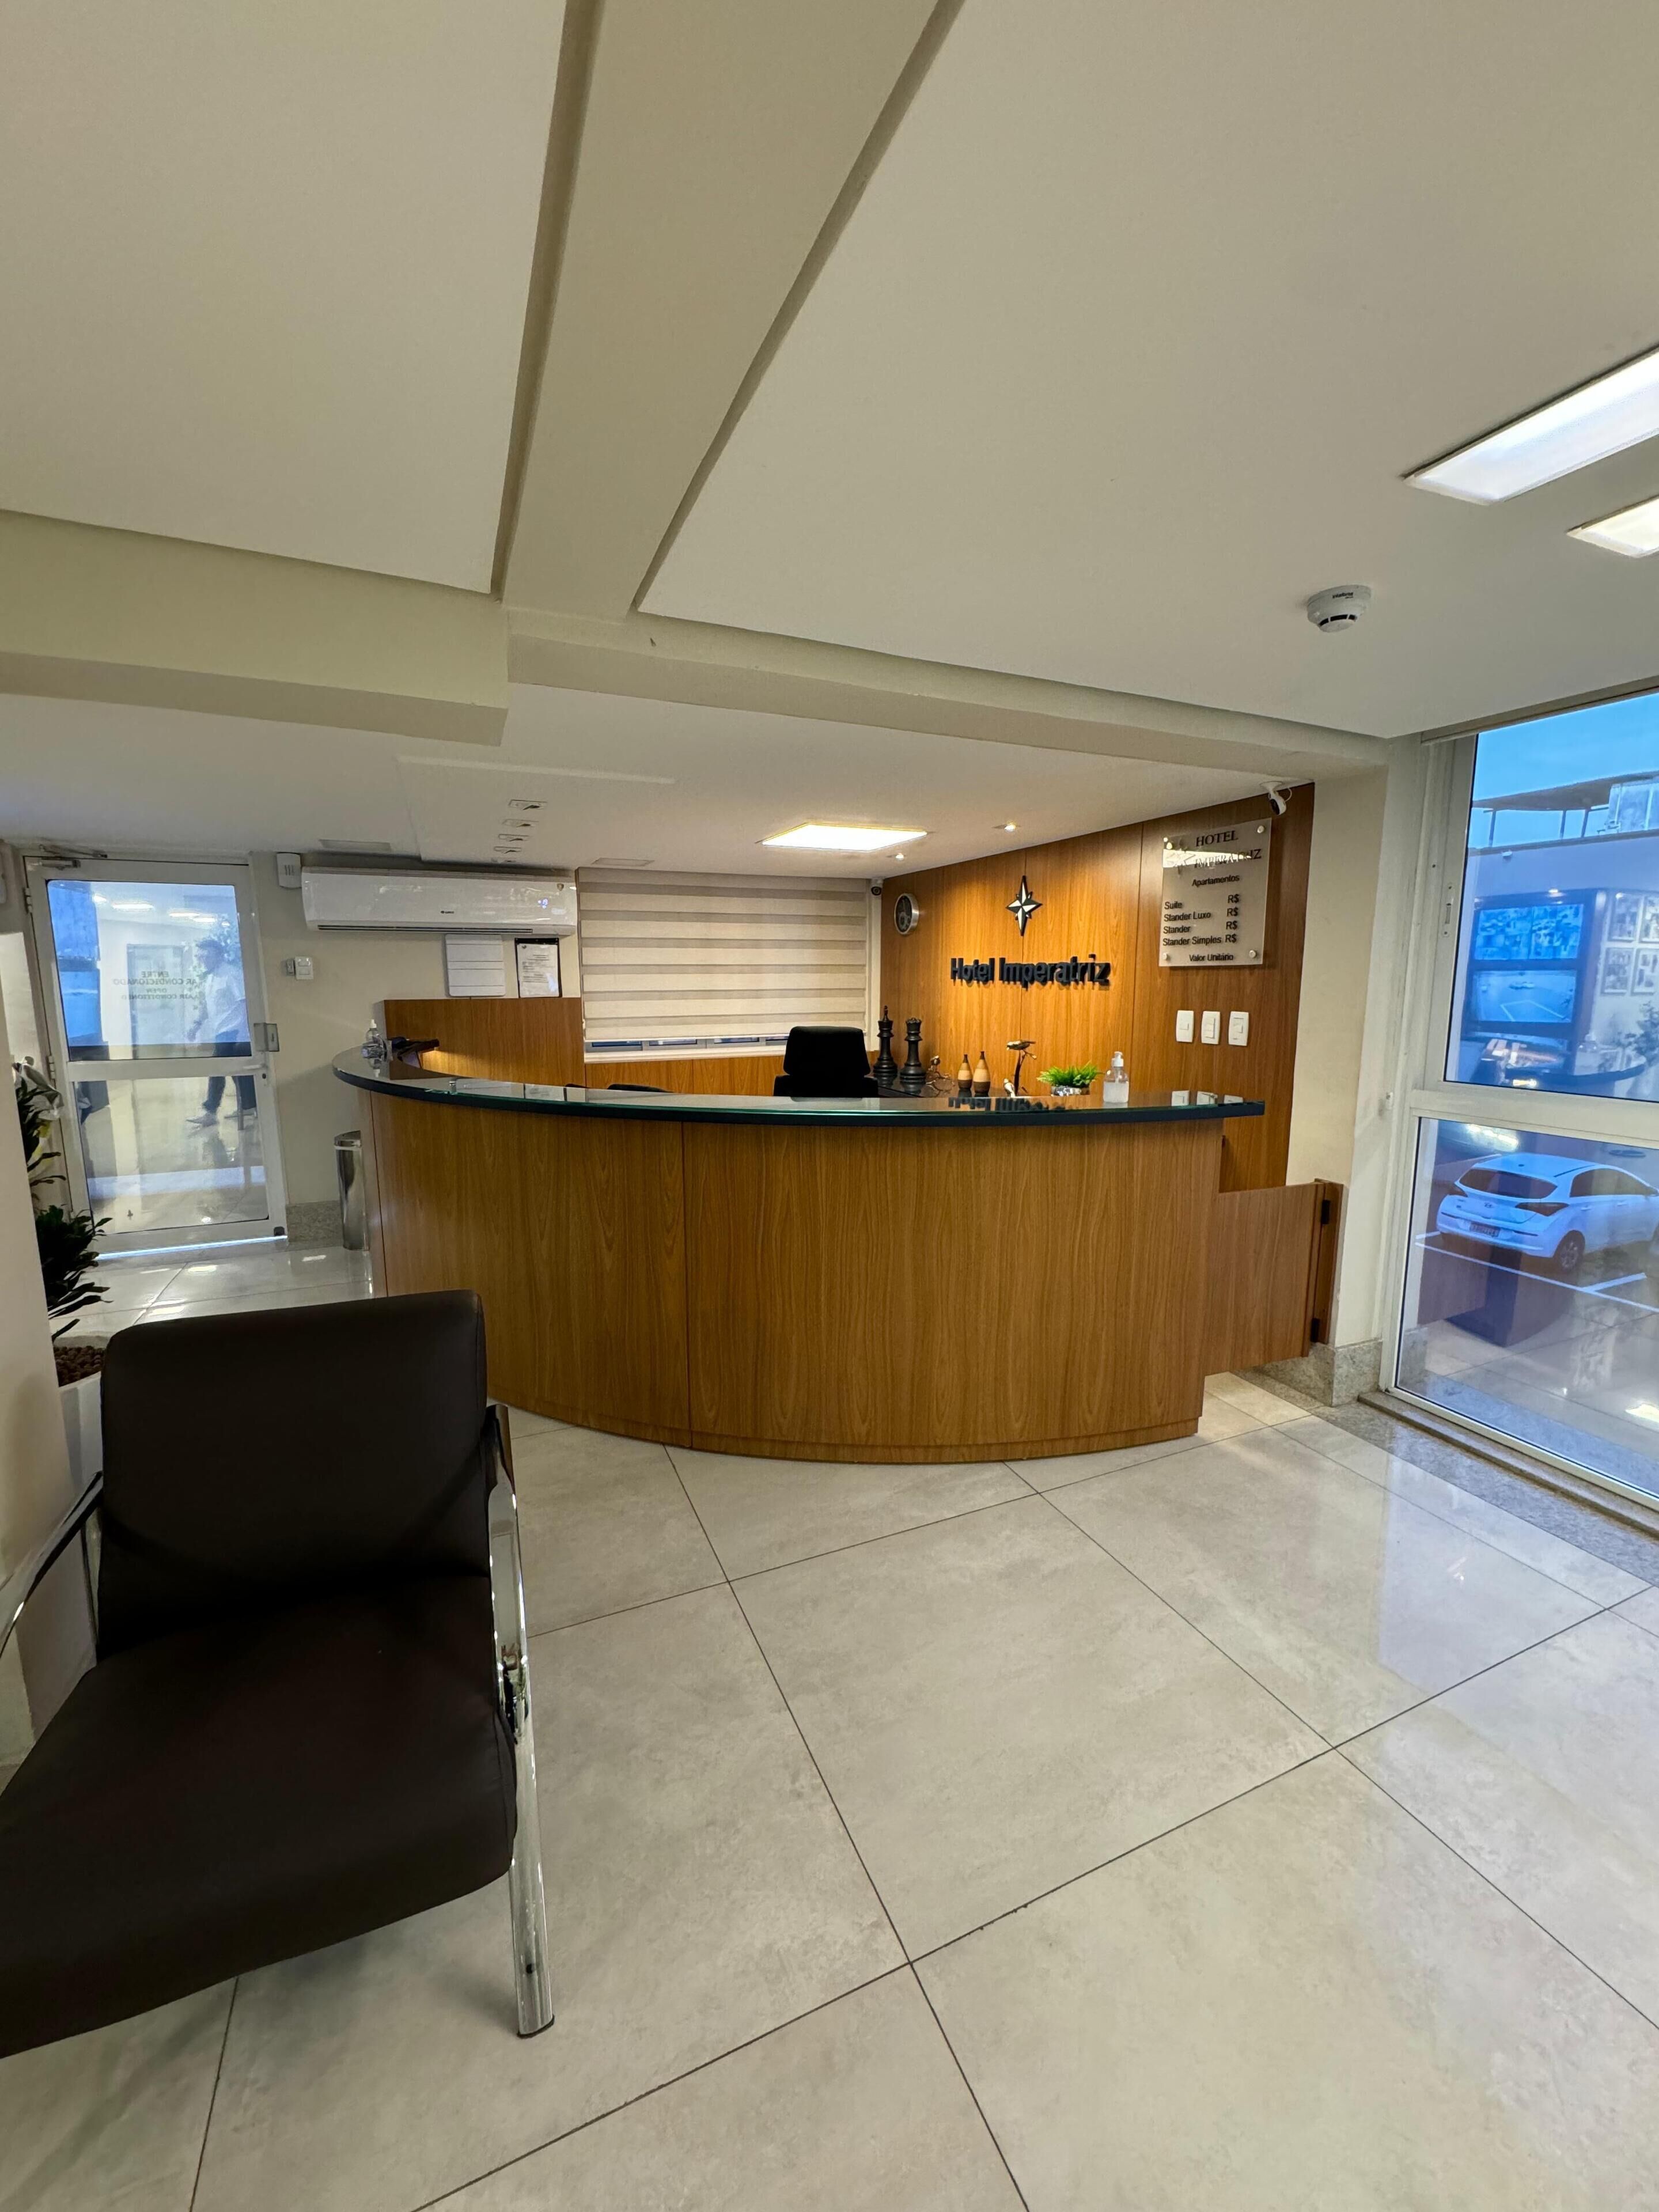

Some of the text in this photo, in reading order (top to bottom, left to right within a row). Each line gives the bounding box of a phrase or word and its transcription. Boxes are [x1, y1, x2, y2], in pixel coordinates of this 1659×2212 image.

[1196, 830, 1238, 847] HOTEL
[1191, 874, 1240, 887] Apartamentos
[1228, 894, 1240, 903] R$
[1164, 907, 1238, 922] Stander Luxo R$
[1163, 921, 1237, 934] Stander R$
[1163, 933, 1237, 946] Stander Simples R$
[950, 954, 1111, 990] Hotel Imperatriz
